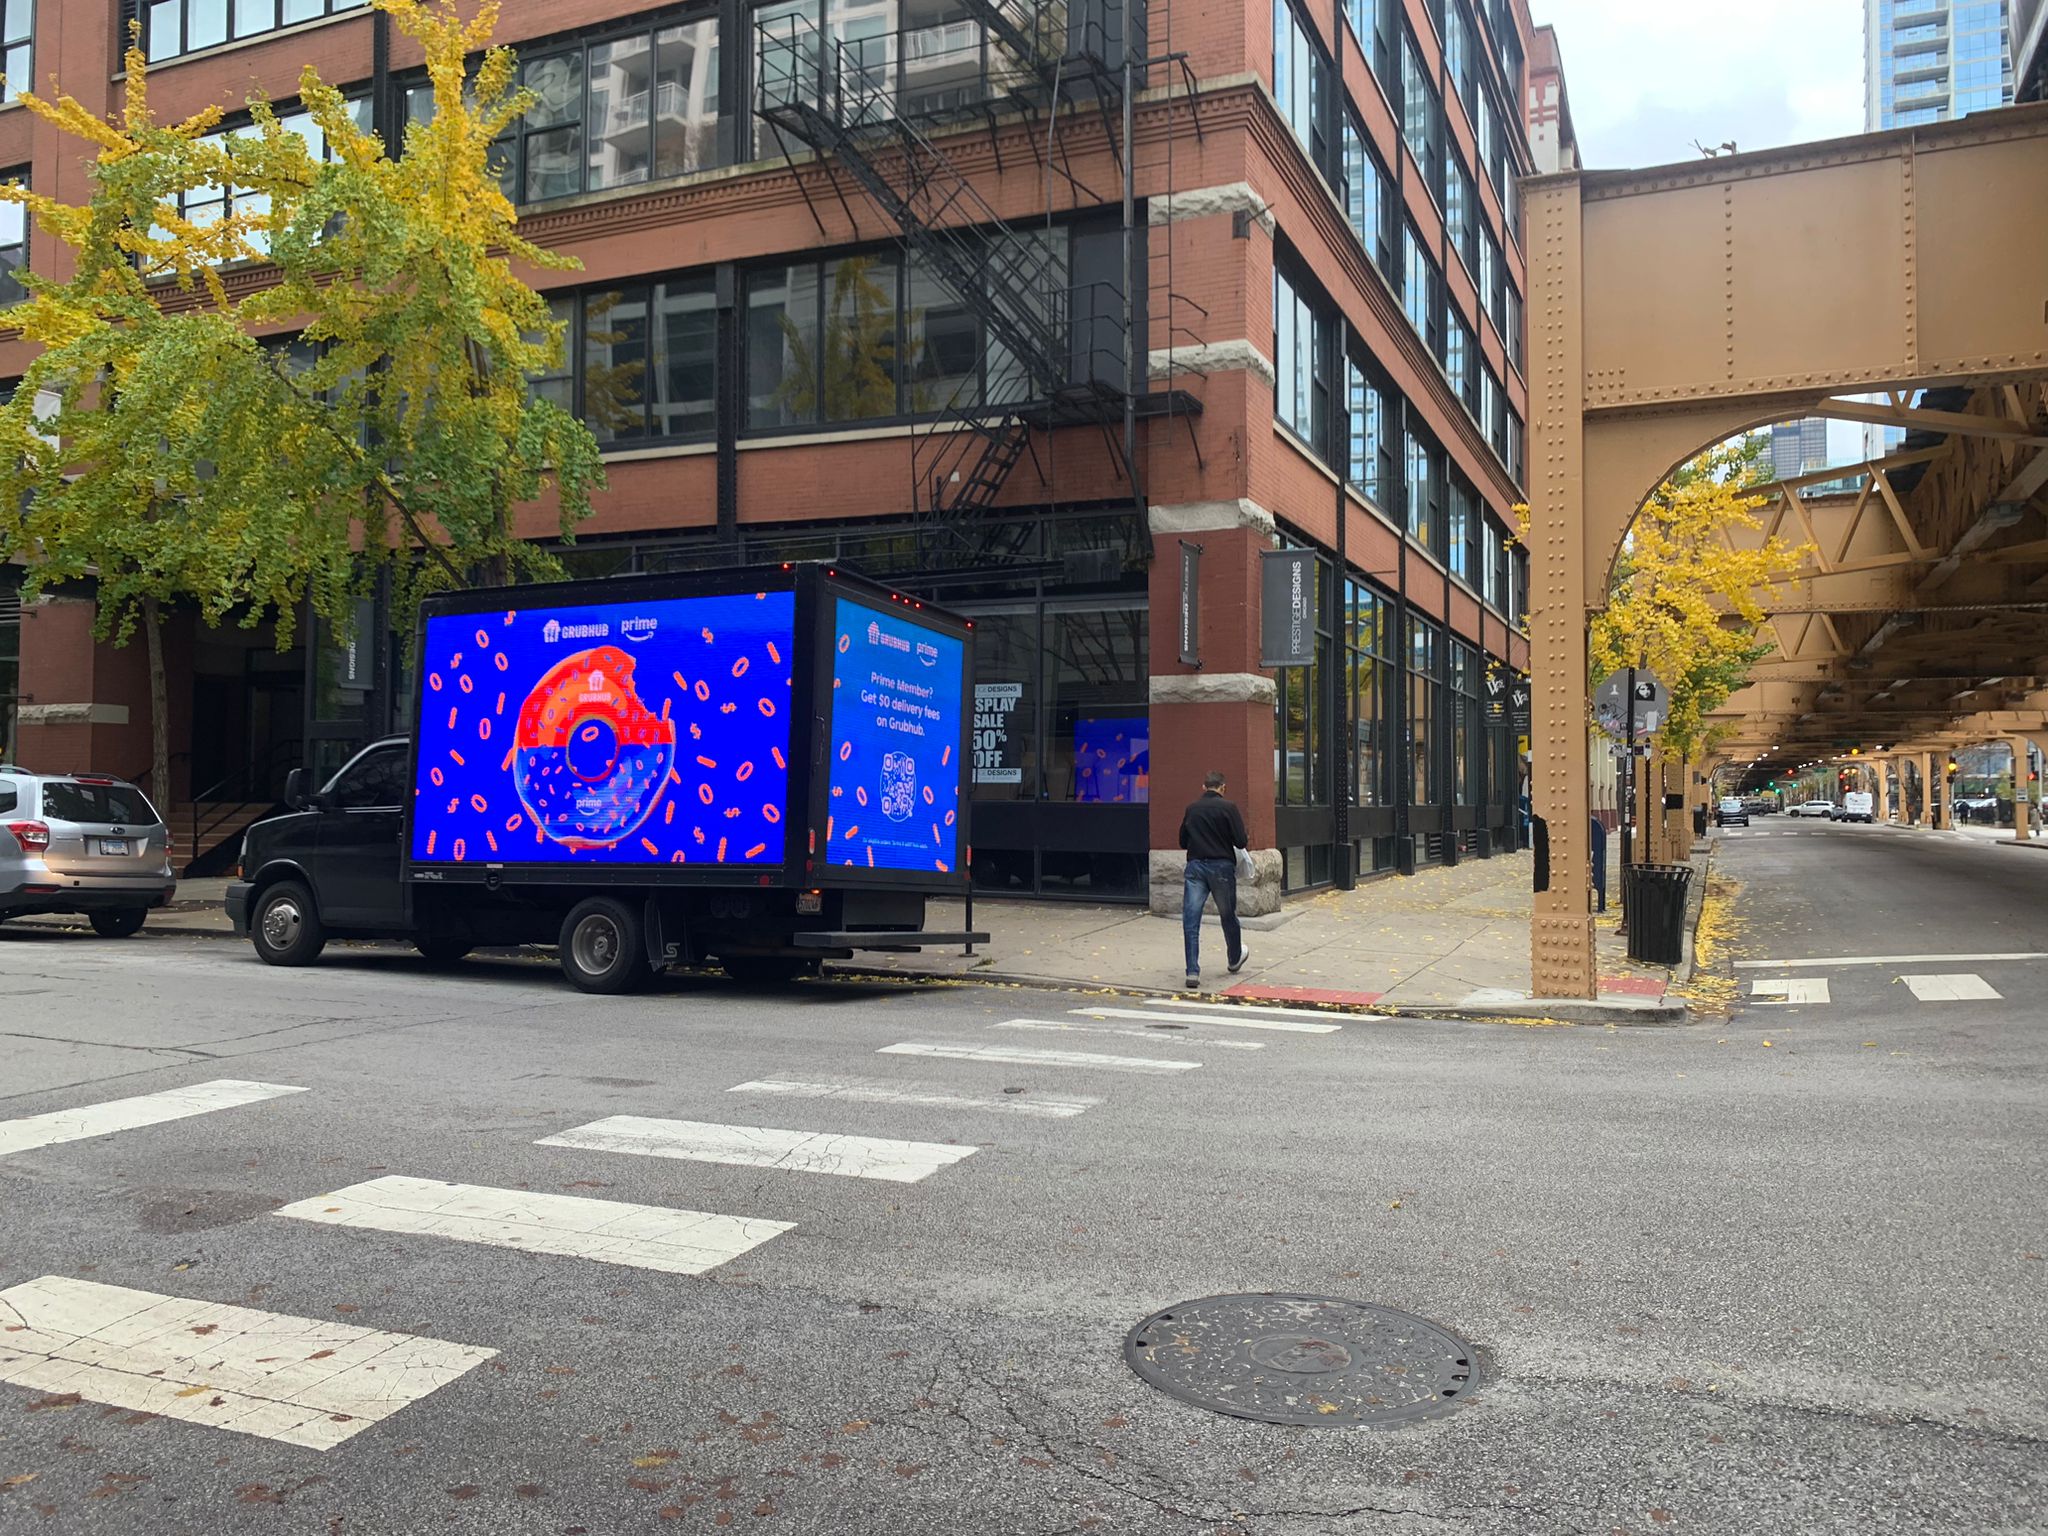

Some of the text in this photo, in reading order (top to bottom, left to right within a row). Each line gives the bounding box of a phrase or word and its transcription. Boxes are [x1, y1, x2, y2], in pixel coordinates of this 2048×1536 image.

[561, 616, 657, 638] GRUBHUB prime
[917, 642, 938, 658] prime
[871, 671, 933, 699] Prime Member?
[861, 689, 940, 720] Get $0 delivery fees
[876, 716, 925, 736] on Grubhub.
[973, 714, 1004, 728] SALE
[973, 729, 1007, 750] 50%
[973, 751, 1002, 768] OFF
